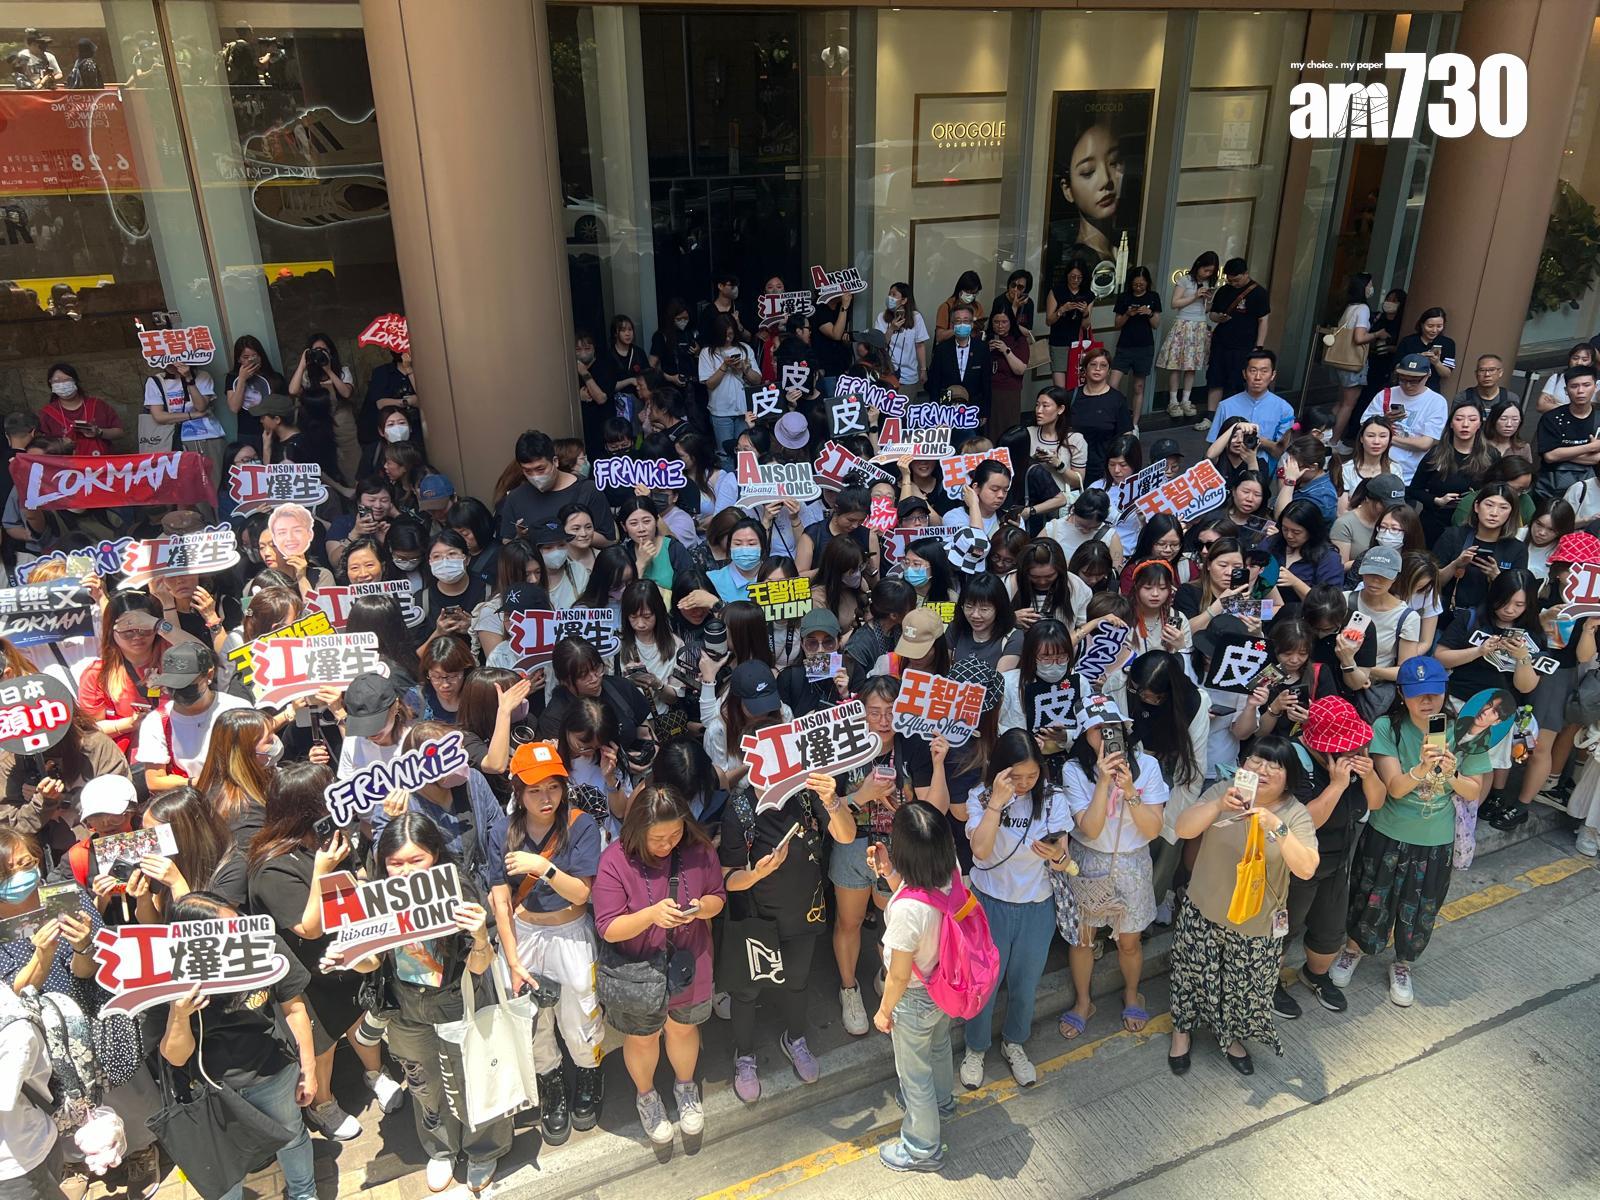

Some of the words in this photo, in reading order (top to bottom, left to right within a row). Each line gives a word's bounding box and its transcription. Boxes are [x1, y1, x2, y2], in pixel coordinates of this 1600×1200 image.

[938, 140, 1002, 150] cosmetics
[812, 267, 861, 289] ANSON
[840, 280, 863, 291] KONG
[139, 327, 215, 358] 王智德
[782, 361, 811, 395] 皮
[752, 387, 783, 418] 皮
[832, 398, 866, 434] 皮
[878, 418, 949, 446] ANSON
[912, 443, 948, 456] KONG
[267, 465, 295, 474] ANSON
[296, 464, 319, 473] KONG
[738, 452, 811, 485] ANSON
[854, 457, 877, 475] ANSON
[25, 452, 181, 510] LOKMAN
[777, 481, 813, 496] KONG
[1137, 461, 1224, 516] 王智德
[172, 532, 205, 545] ANSON
[206, 531, 232, 542] KONG
[919, 528, 945, 537] ANSON
[350, 584, 382, 599] ANSON
[383, 581, 410, 594] KONG
[747, 577, 811, 606] 王智德
[555, 609, 587, 621] ANSON
[588, 609, 613, 620] KONG
[763, 599, 813, 622] LTON
[306, 636, 344, 648] ANSON
[345, 634, 375, 645] KONG
[1212, 640, 1268, 688] 皮
[0, 680, 46, 705] 日本
[895, 672, 986, 727] 王智德
[793, 711, 831, 733] ANSON
[831, 701, 863, 721] KONG
[1032, 685, 1077, 733] 皮
[319, 865, 459, 931] ANSON
[171, 922, 224, 938] ANSON
[228, 916, 271, 935] KONG
